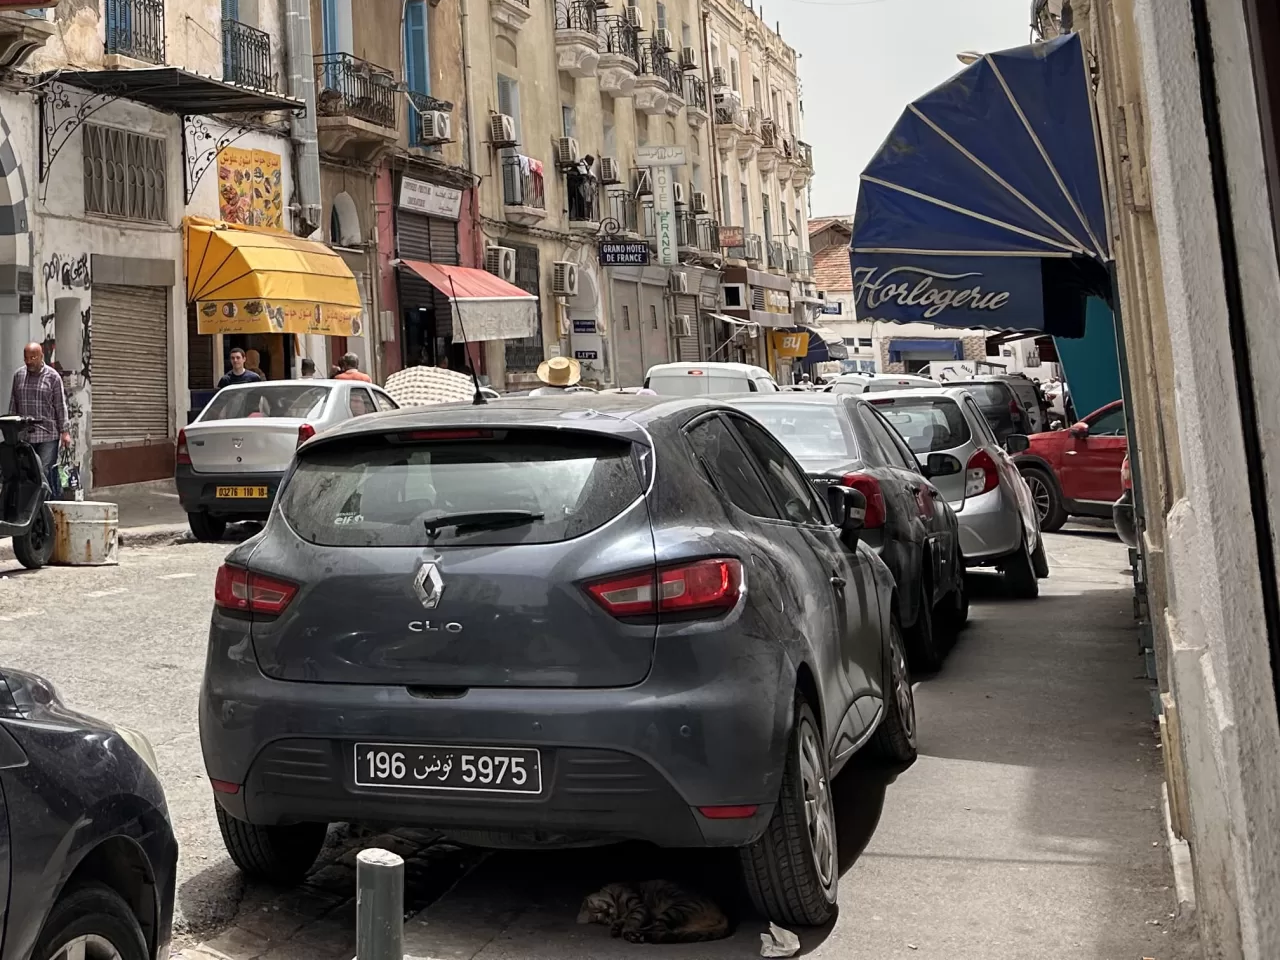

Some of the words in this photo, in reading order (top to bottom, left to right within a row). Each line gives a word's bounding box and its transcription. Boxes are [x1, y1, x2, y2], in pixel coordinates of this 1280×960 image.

[657, 166, 668, 210] HOTEL
[603, 244, 625, 253] GRAND
[660, 215, 672, 265] FRANCE
[606, 254, 615, 262] DE
[616, 253, 642, 262] FRANCE
[854, 266, 1009, 318] Horlogerie
[218, 487, 238, 496] 03276
[243, 487, 253, 496] 110
[334, 515, 353, 525] elf
[366, 751, 406, 779] 196
[413, 753, 454, 780] تونس
[461, 755, 527, 785] 5975
